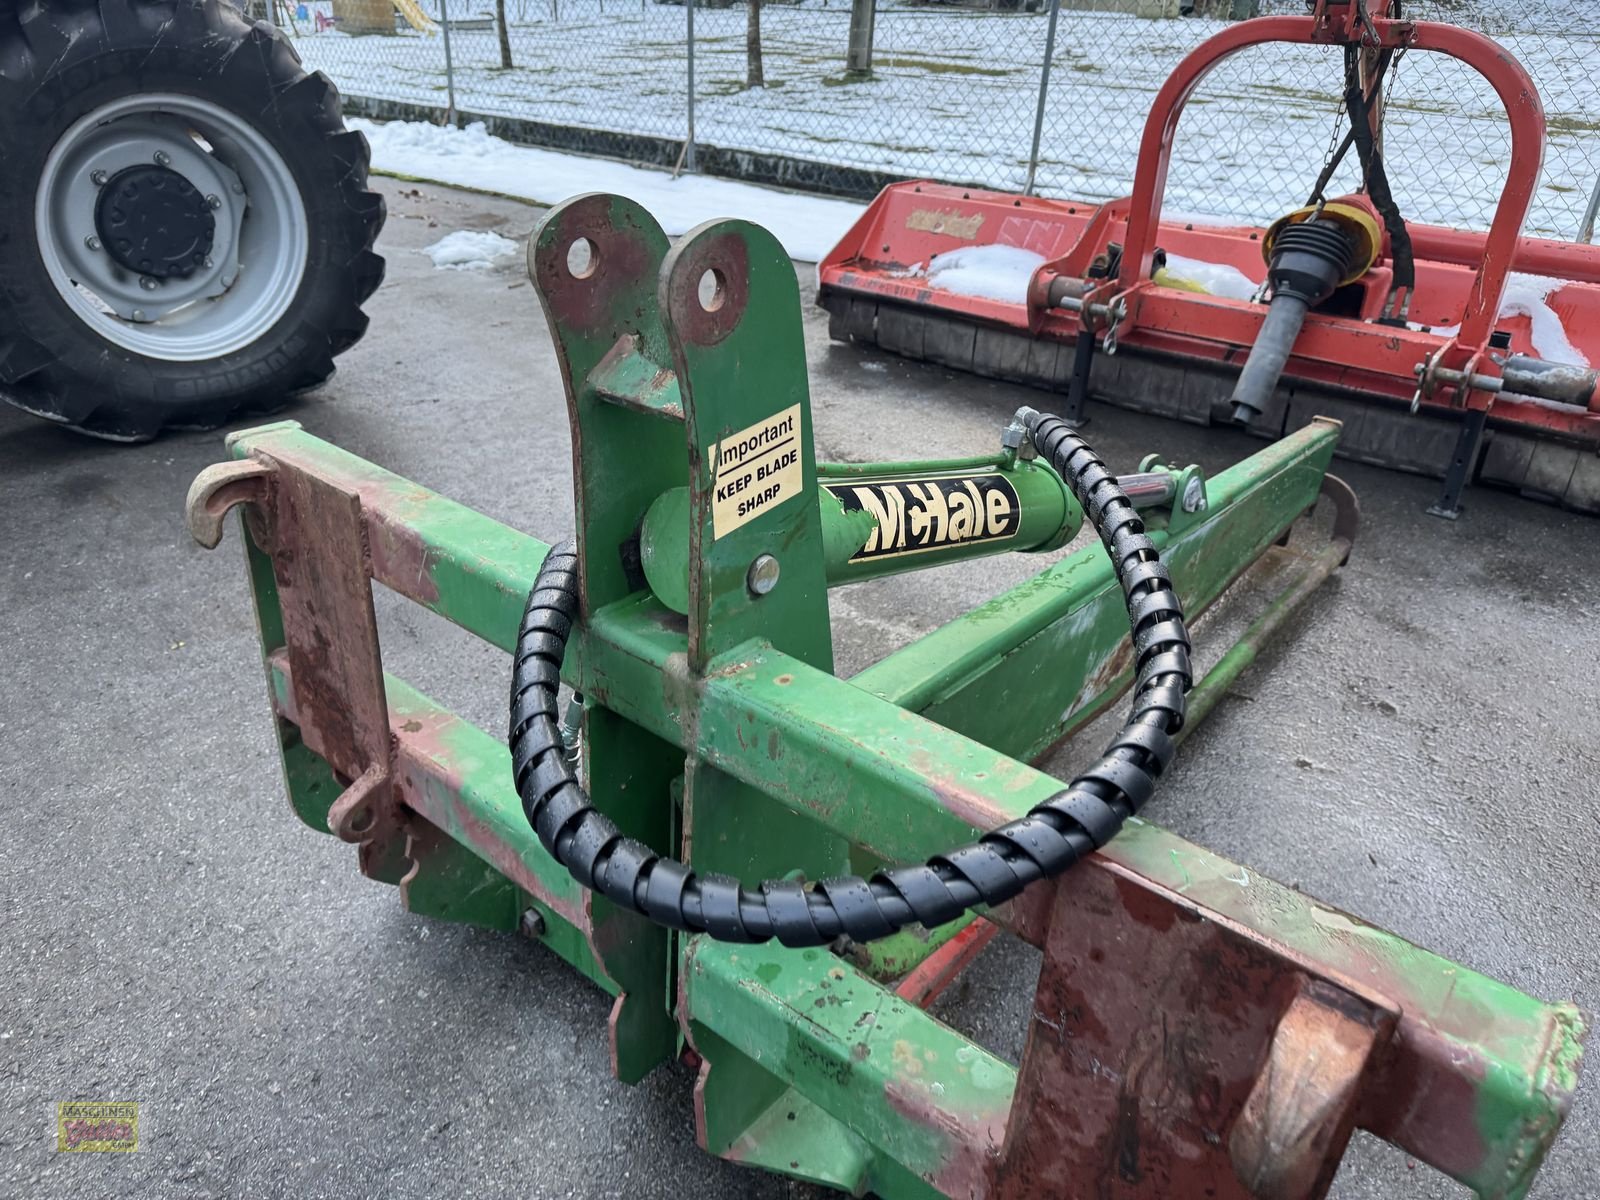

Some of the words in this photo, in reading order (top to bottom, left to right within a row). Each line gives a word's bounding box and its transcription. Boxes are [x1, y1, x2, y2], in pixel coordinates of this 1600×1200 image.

[719, 415, 793, 466] Important
[717, 473, 752, 503] KEEP
[756, 449, 798, 481] BLADE
[738, 483, 781, 516] SHARP
[852, 479, 1011, 552] McHale
